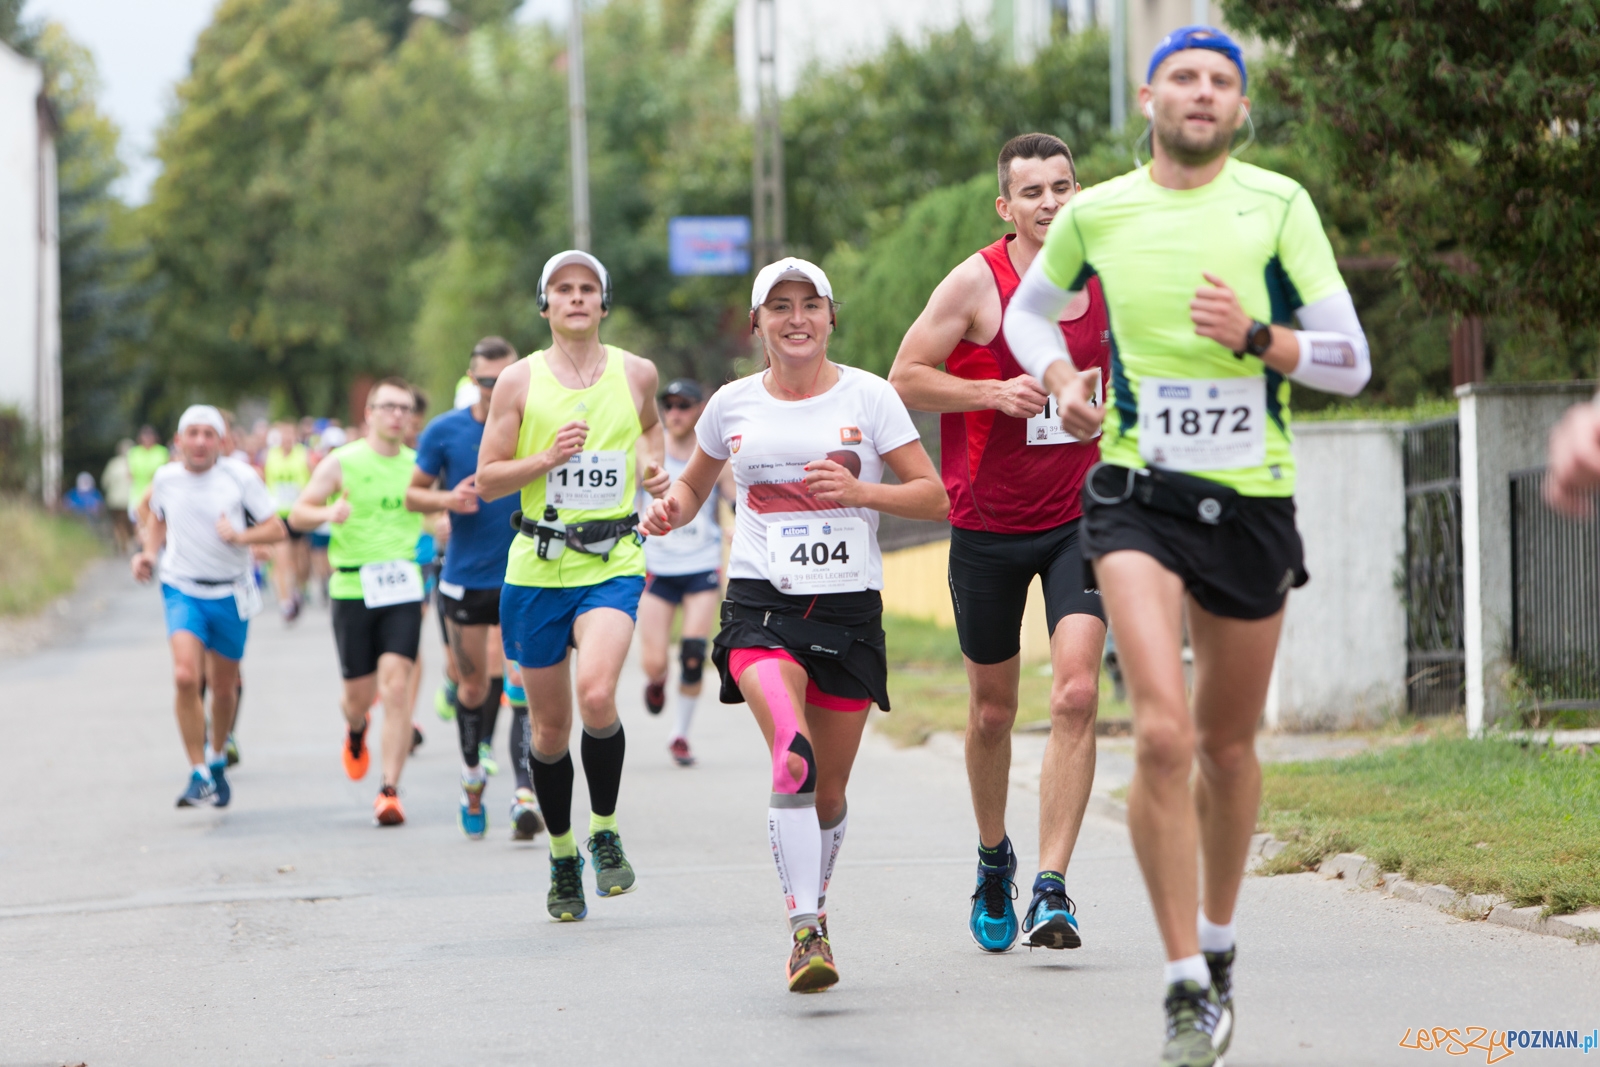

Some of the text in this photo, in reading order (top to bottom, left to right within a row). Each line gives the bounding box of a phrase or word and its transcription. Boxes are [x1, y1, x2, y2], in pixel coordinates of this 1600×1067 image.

[1157, 406, 1250, 435] 1872
[557, 468, 617, 487] 1195
[790, 541, 849, 566] 404
[805, 572, 823, 580] BIEG
[825, 570, 859, 579] LECHITÓW
